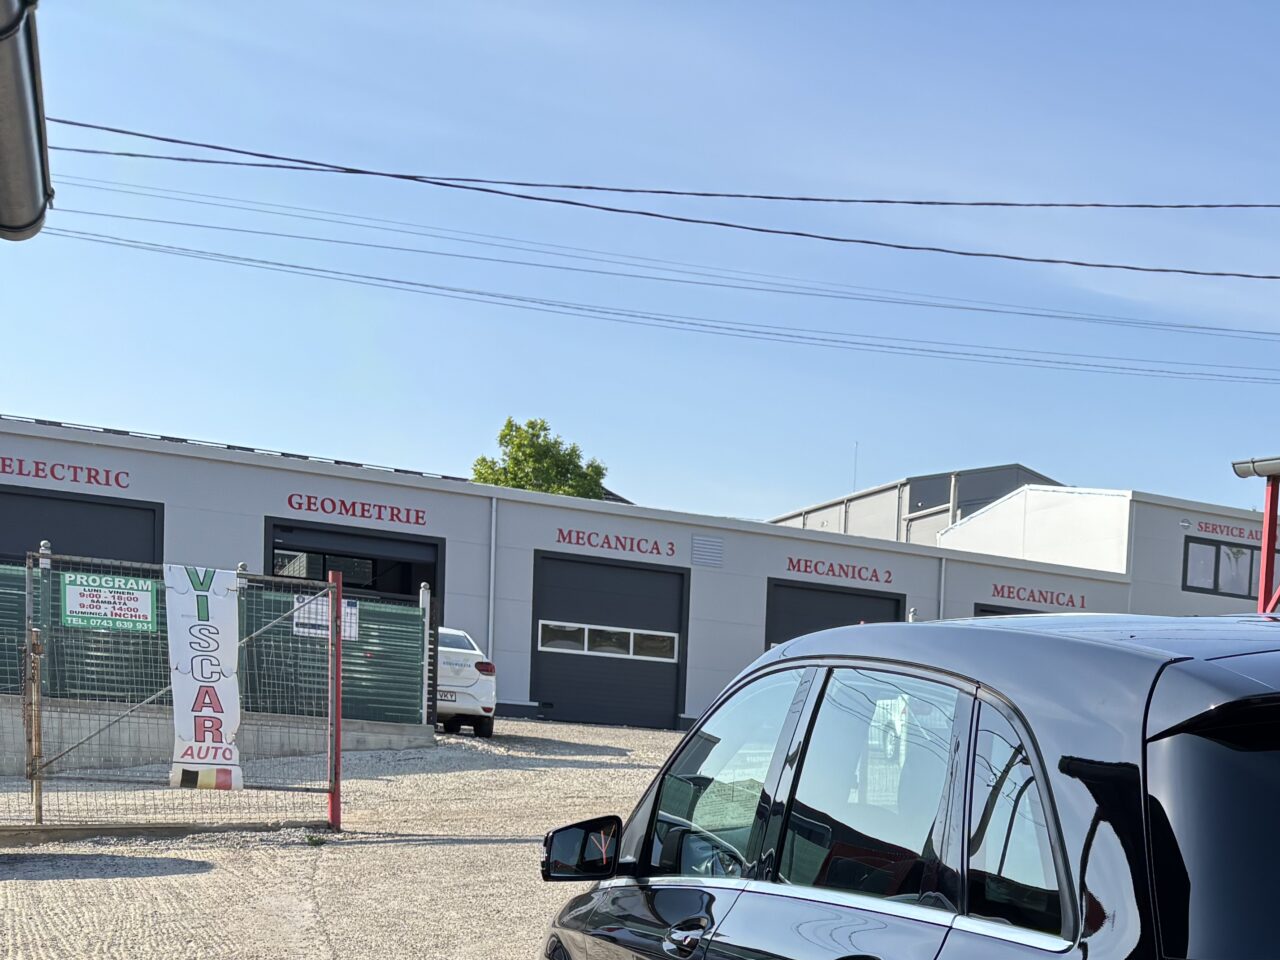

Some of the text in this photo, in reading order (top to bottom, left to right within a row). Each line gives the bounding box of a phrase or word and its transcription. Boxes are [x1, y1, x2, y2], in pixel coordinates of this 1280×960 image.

[0, 456, 130, 489] ELECTRIC
[287, 493, 427, 526] GEOMETRIE
[556, 528, 676, 557] MECANICA 3
[1197, 521, 1245, 538] SERVICE
[64, 573, 152, 591] PROGRAM
[787, 557, 893, 584] MECANICA 2
[992, 583, 1087, 609] MECANICA 1
[66, 617, 152, 630] TEL: 0743 639 931
[184, 566, 224, 743] VISCAR
[180, 745, 233, 761] AUTO
